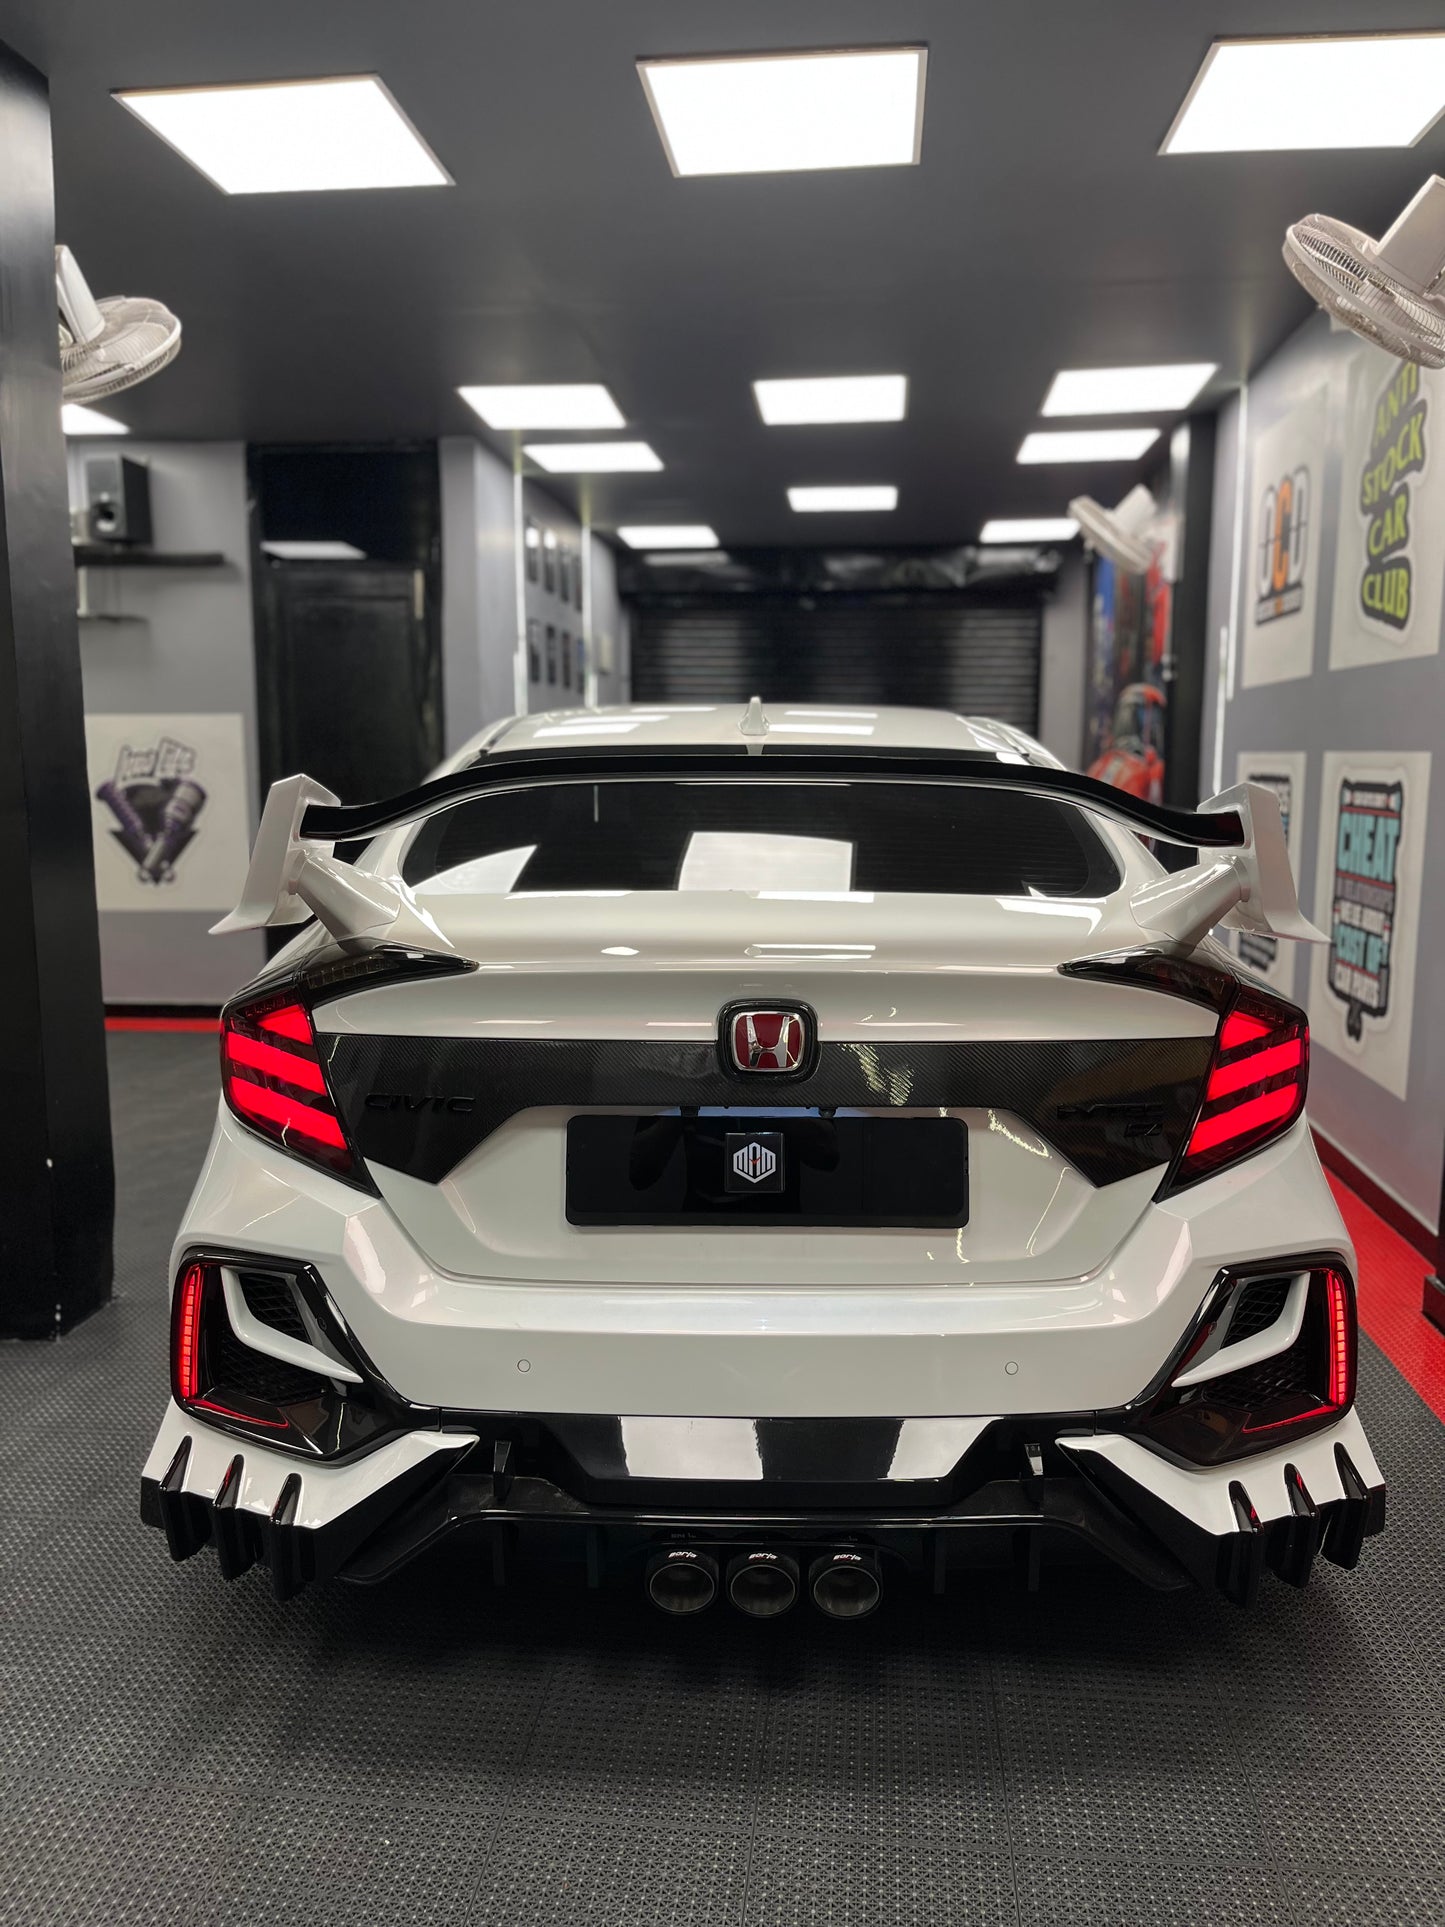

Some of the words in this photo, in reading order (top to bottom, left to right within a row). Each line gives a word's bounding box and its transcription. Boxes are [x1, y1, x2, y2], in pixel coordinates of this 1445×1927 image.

[1373, 361, 1418, 450] ANTI
[1363, 412, 1424, 505] STOCK
[1369, 496, 1407, 556] CAR
[1363, 568, 1409, 620] CLUB
[1336, 811, 1400, 883] CHEAT
[1336, 923, 1365, 968] COST
[365, 1092, 476, 1112] CIVIC
